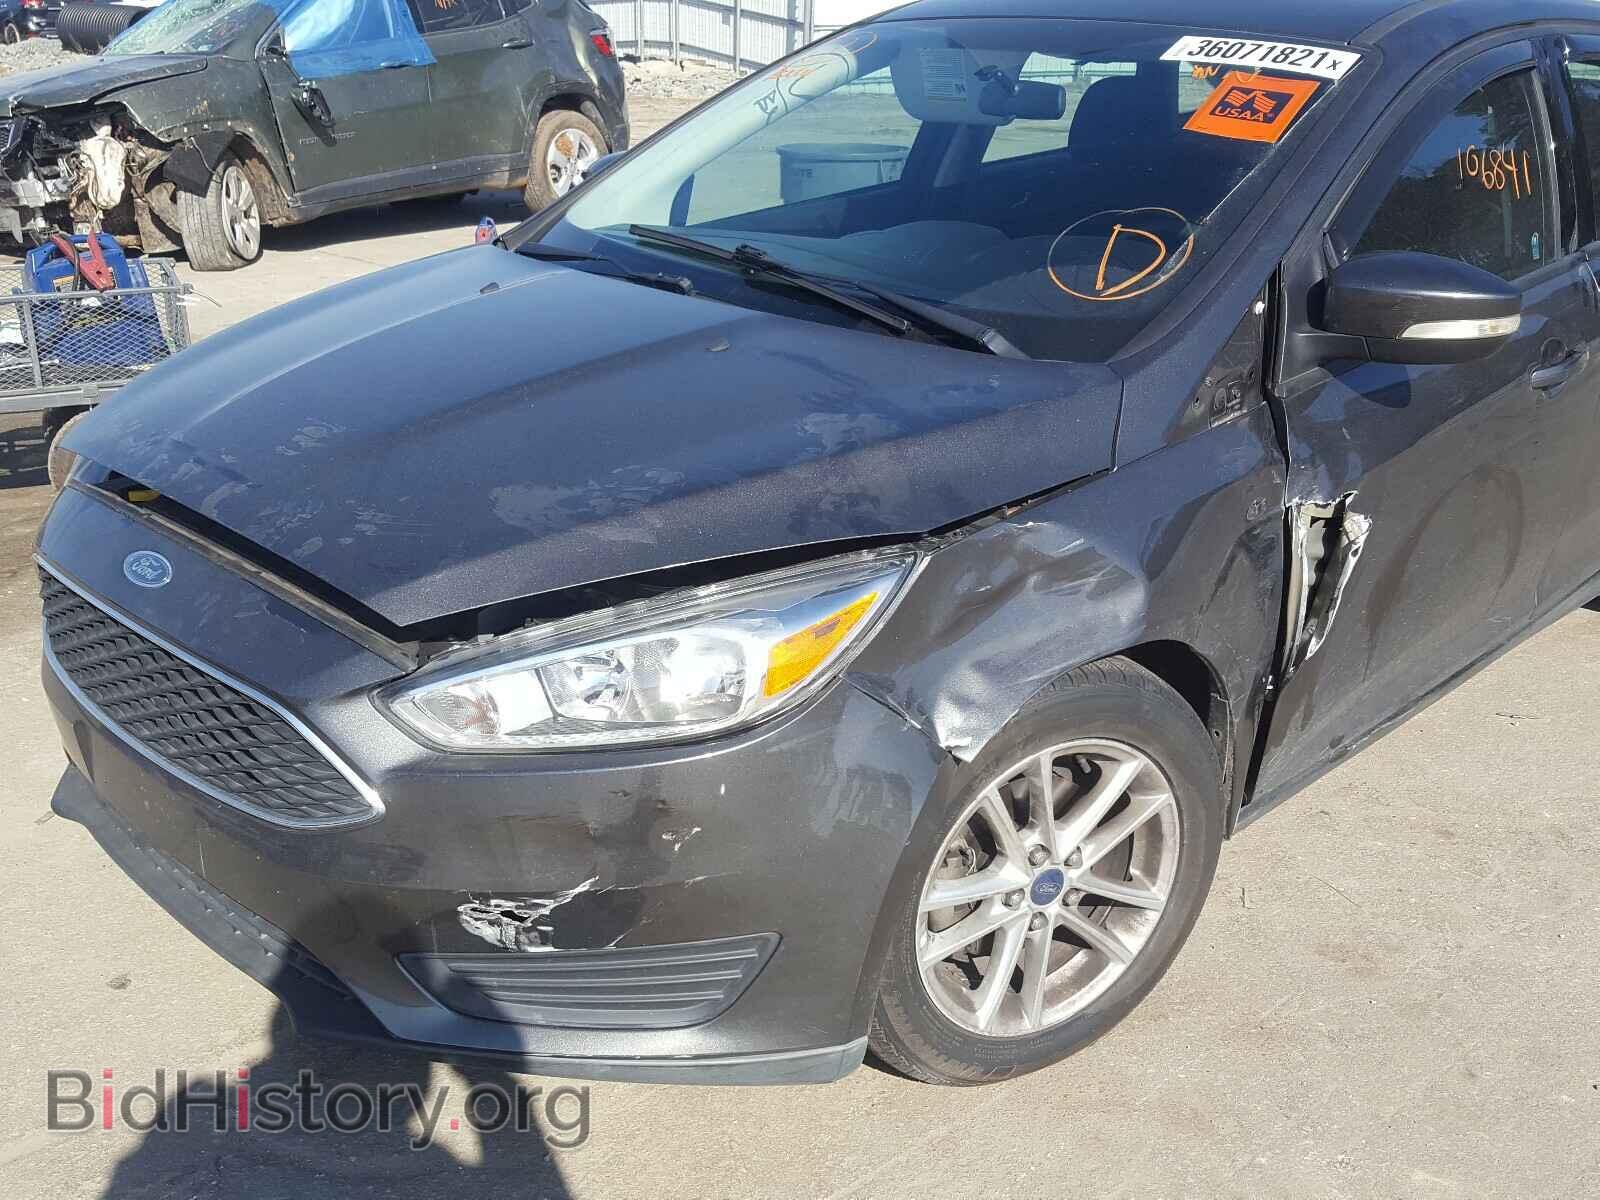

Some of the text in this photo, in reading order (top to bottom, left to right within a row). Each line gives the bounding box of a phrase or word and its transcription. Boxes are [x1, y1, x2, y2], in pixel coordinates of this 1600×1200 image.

[1187, 39, 1331, 69] 36071821
[1215, 106, 1265, 122] USAA
[1095, 223, 1167, 297] D
[131, 557, 164, 580] Ford
